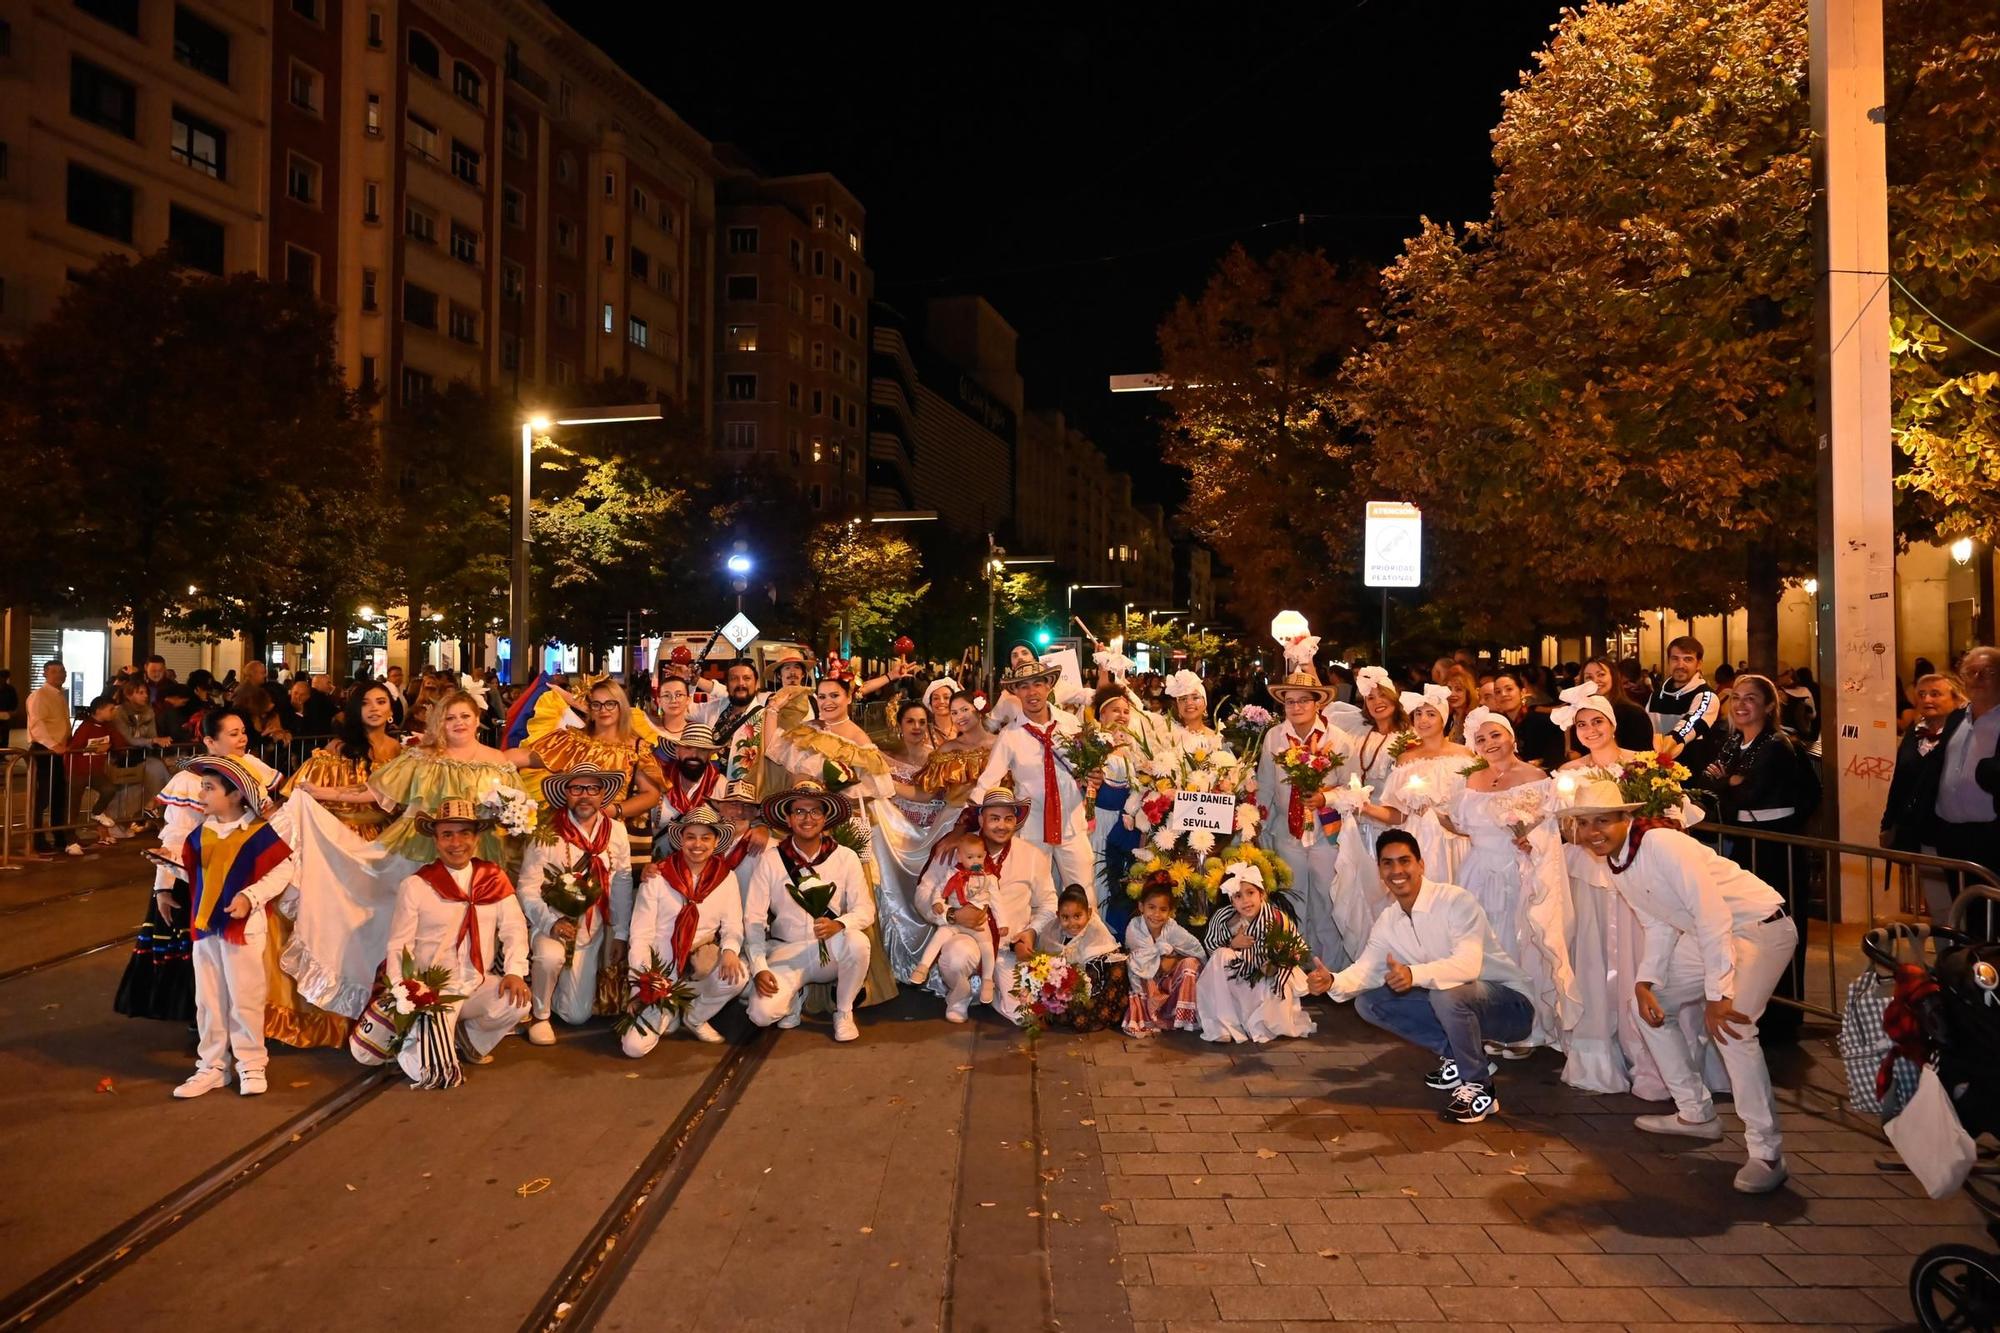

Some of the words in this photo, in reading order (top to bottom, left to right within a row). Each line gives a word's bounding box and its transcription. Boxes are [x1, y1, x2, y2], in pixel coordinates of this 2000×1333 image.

[1371, 564, 1415, 572] PRIORIDAD
[1372, 574, 1413, 582] PEATONAL
[732, 624, 749, 638] 30
[1841, 724, 1859, 739] AWA
[1177, 792, 1198, 802] LUIS
[1200, 794, 1233, 806] DANIEL
[1197, 806, 1206, 816] G.
[1182, 817, 1220, 830] SEVILLA
